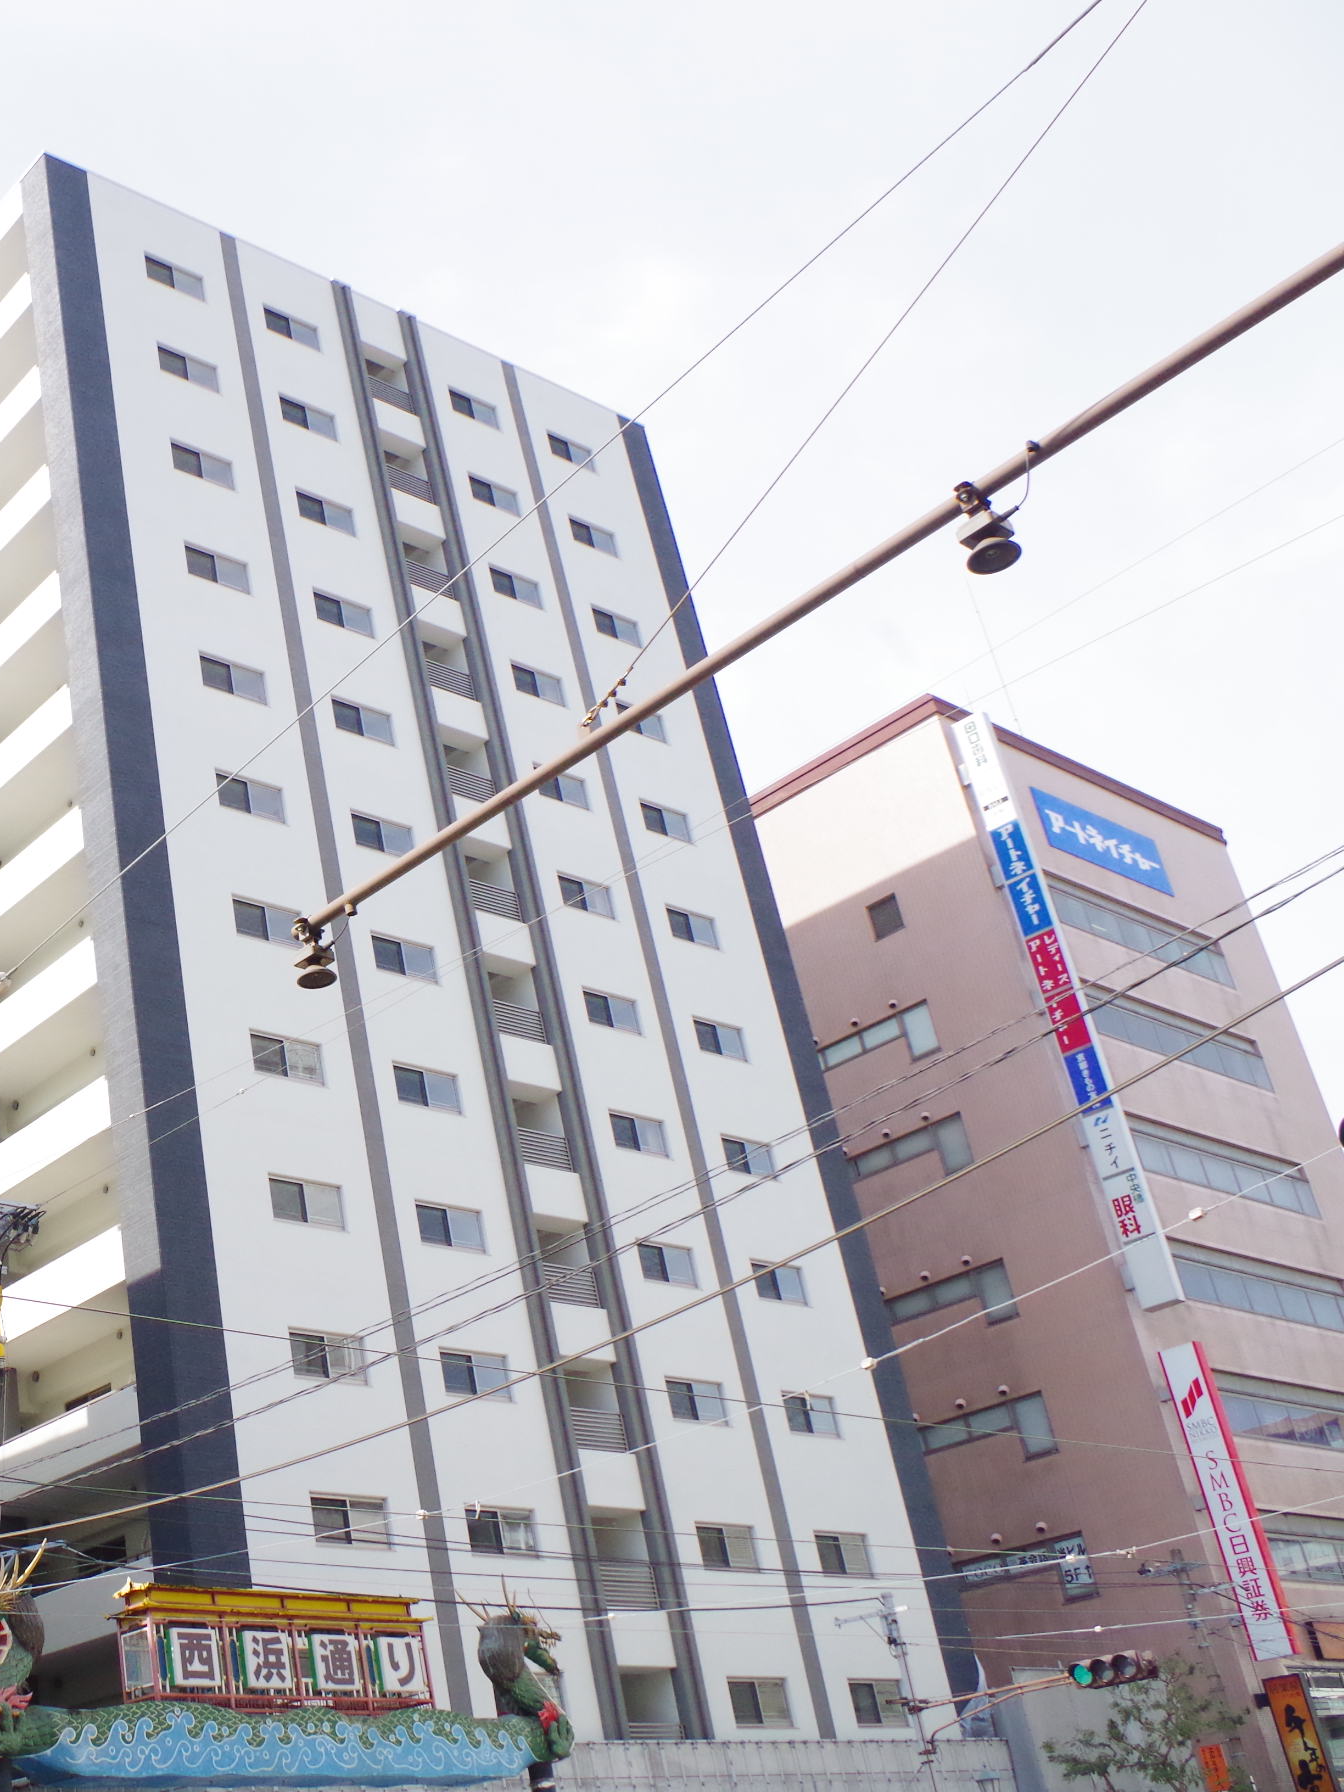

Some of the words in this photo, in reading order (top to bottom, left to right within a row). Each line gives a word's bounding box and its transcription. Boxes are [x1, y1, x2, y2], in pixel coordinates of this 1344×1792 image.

[997, 823, 1041, 926] アートネイチャー
[1043, 934, 1070, 986] レディース
[1099, 1127, 1120, 1169] ニチイ
[1112, 1194, 1142, 1239] 眼科
[1205, 1450, 1272, 1621] SMBC日興証券
[177, 1631, 419, 1688] 西浜通り
